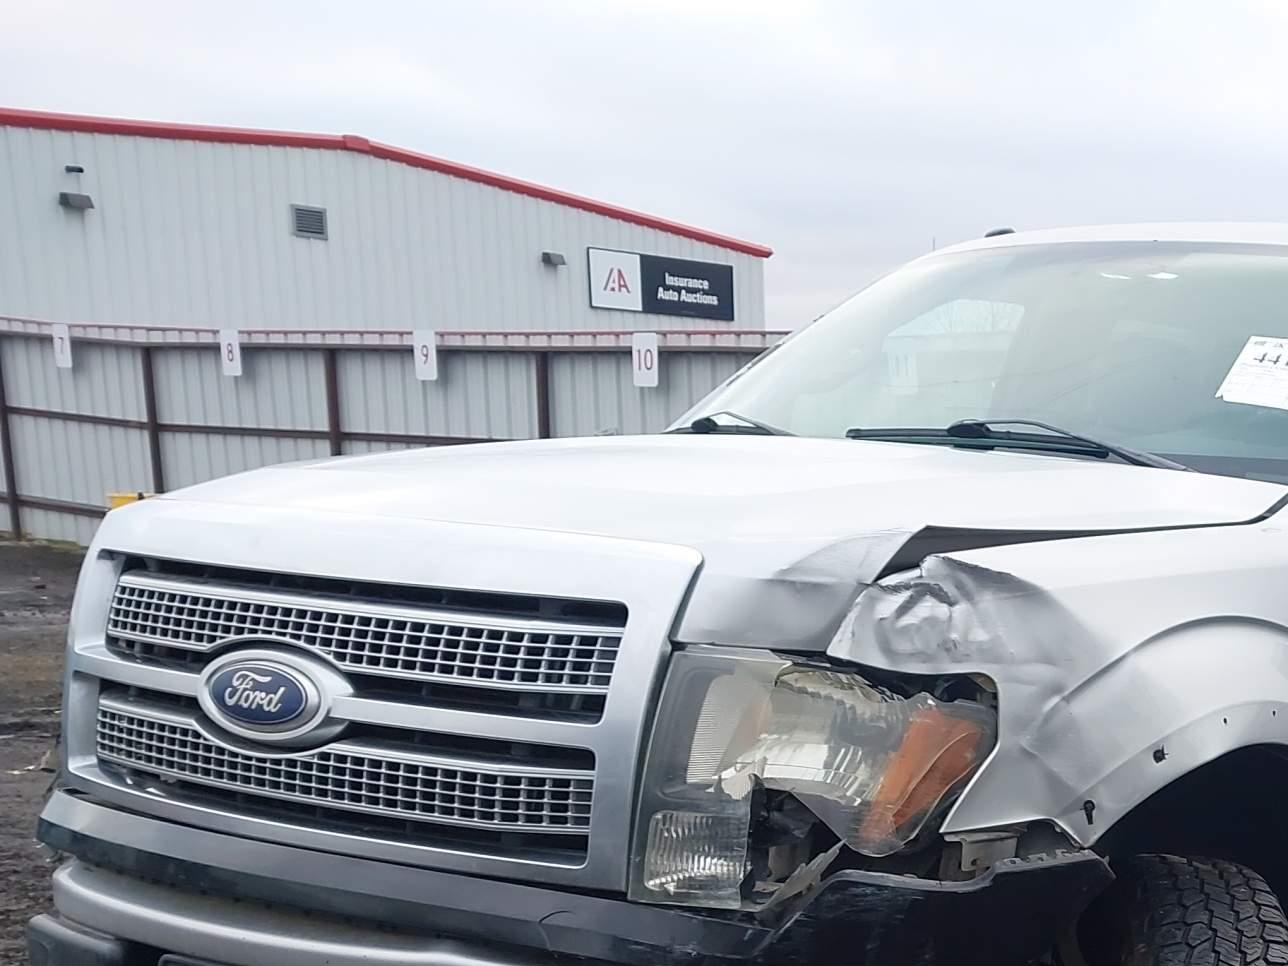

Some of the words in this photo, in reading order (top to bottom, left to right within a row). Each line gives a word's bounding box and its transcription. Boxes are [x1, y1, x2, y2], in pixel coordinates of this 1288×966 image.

[665, 272, 709, 289] Insurance
[657, 287, 678, 301] Auto
[680, 290, 718, 305] Auctions
[226, 343, 234, 362] 8
[420, 345, 429, 365] 9
[636, 348, 654, 371] 10
[224, 670, 286, 713] Ford
